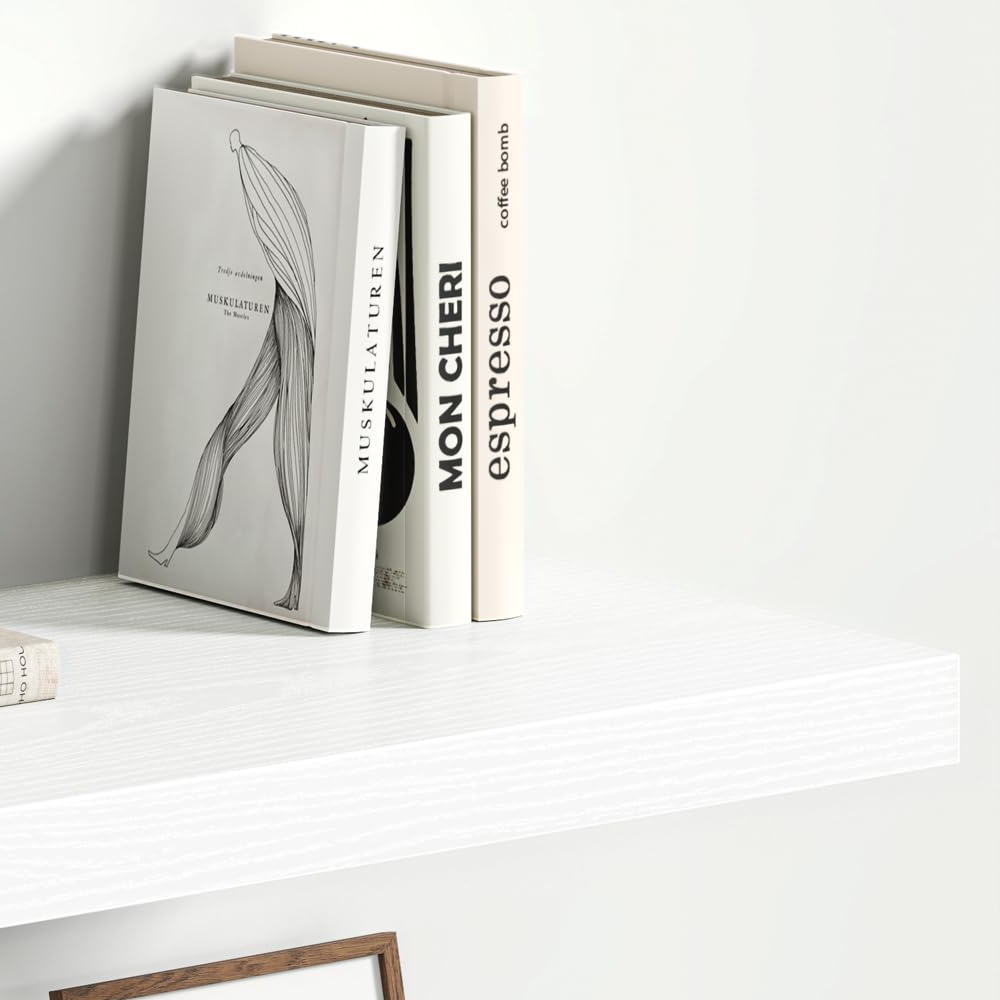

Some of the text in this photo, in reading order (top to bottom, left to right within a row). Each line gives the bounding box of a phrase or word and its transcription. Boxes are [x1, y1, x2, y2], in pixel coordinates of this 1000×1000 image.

[497, 122, 510, 229] coffee bomb
[207, 292, 270, 314] MUSKULATUREN
[357, 245, 385, 475] MUSKULATUREN
[438, 261, 463, 491] MON CHERI
[487, 275, 517, 481] espresso
